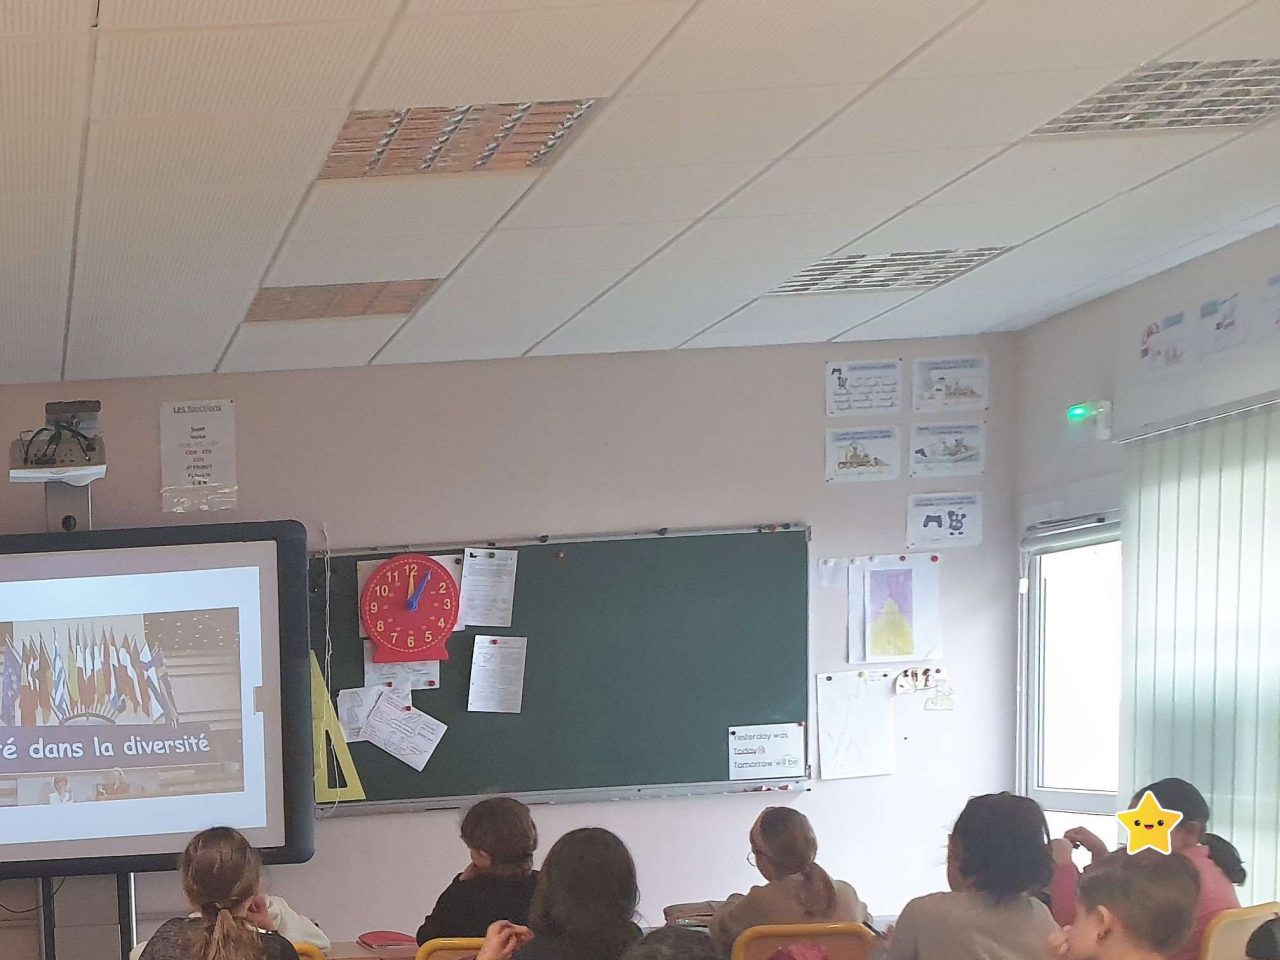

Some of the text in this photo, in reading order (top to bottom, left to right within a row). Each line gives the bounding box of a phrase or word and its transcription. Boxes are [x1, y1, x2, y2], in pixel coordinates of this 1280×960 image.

[405, 564, 417, 575] 12
[387, 571, 399, 582] 11
[375, 585, 388, 596] 10
[439, 583, 446, 593] 2
[371, 602, 377, 613] 9
[444, 599, 450, 609] 3
[377, 621, 384, 631] 8
[438, 617, 445, 628] 4
[391, 633, 398, 643] 7
[425, 631, 432, 641] 5
[407, 637, 414, 647] 6
[29, 738, 83, 760] dans
[93, 736, 114, 758] la
[123, 734, 211, 757] diversité
[733, 761, 773, 769] Tomorrow
